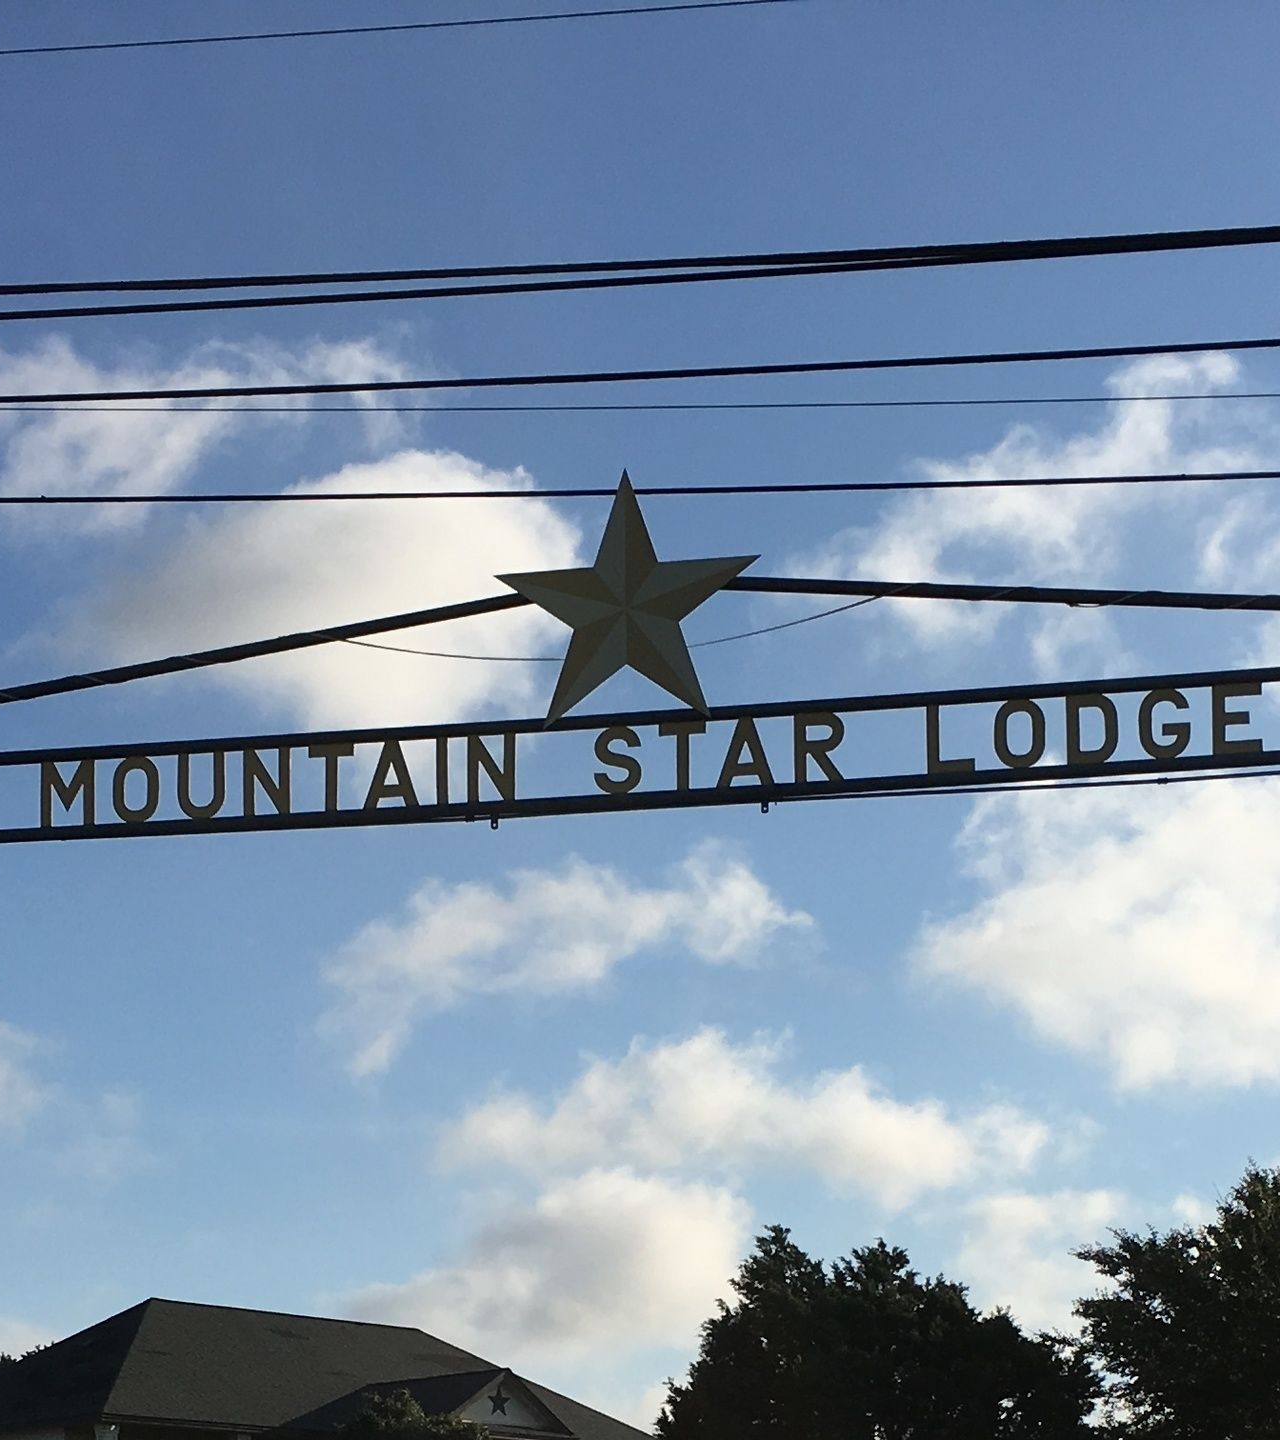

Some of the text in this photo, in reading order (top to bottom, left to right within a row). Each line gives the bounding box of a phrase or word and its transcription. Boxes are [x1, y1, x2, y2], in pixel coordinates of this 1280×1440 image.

[40, 682, 1264, 829] MOUNTAIN STAR LODGE
